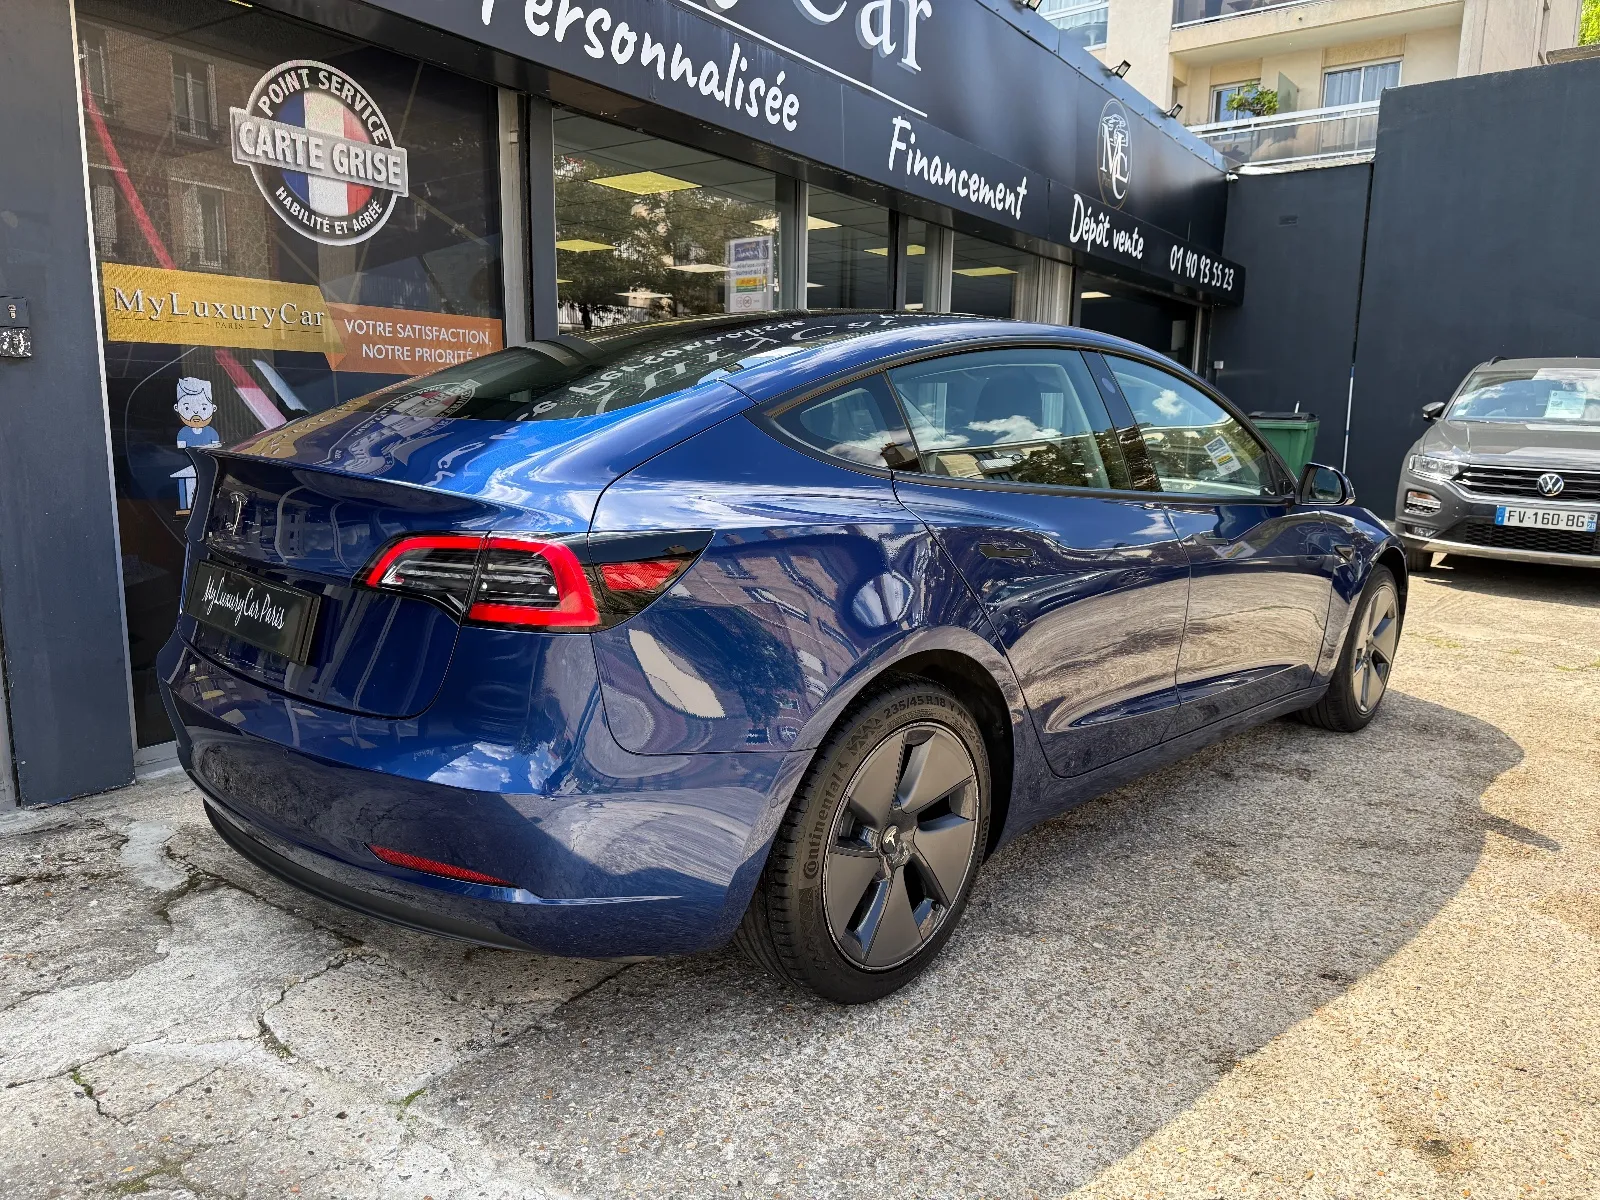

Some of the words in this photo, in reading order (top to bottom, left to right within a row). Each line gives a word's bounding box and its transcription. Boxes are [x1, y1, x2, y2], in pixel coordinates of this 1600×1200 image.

[800, 0, 932, 72] ar
[258, 69, 310, 117] POINT
[318, 71, 388, 144] SERVICE
[239, 121, 325, 170] CARTE
[333, 143, 402, 185] GRISE
[889, 116, 1027, 220] Financement
[276, 186, 330, 233] HABILITÉ
[335, 221, 348, 234] ET
[353, 199, 383, 232] AGRÉÉ
[1070, 193, 1110, 252] Dépôt
[1113, 227, 1144, 259] vente
[1170, 245, 1184, 274] 01
[1186, 250, 1198, 278] 40
[1200, 255, 1211, 283] 93
[1212, 262, 1222, 286] 55
[1223, 268, 1234, 291] 23
[111, 286, 325, 328] MyLuxuryCar
[215, 321, 244, 330] PARIS
[343, 318, 393, 337] VOTRE
[396, 323, 492, 347] SATISFACTION,
[362, 343, 411, 361] NOTRE
[415, 347, 473, 365] PRIORITÉ
[1507, 510, 1586, 528] FV-160-BG
[259, 593, 284, 629] Paris
[884, 696, 924, 719] 235/45
[803, 772, 844, 879] Continental
